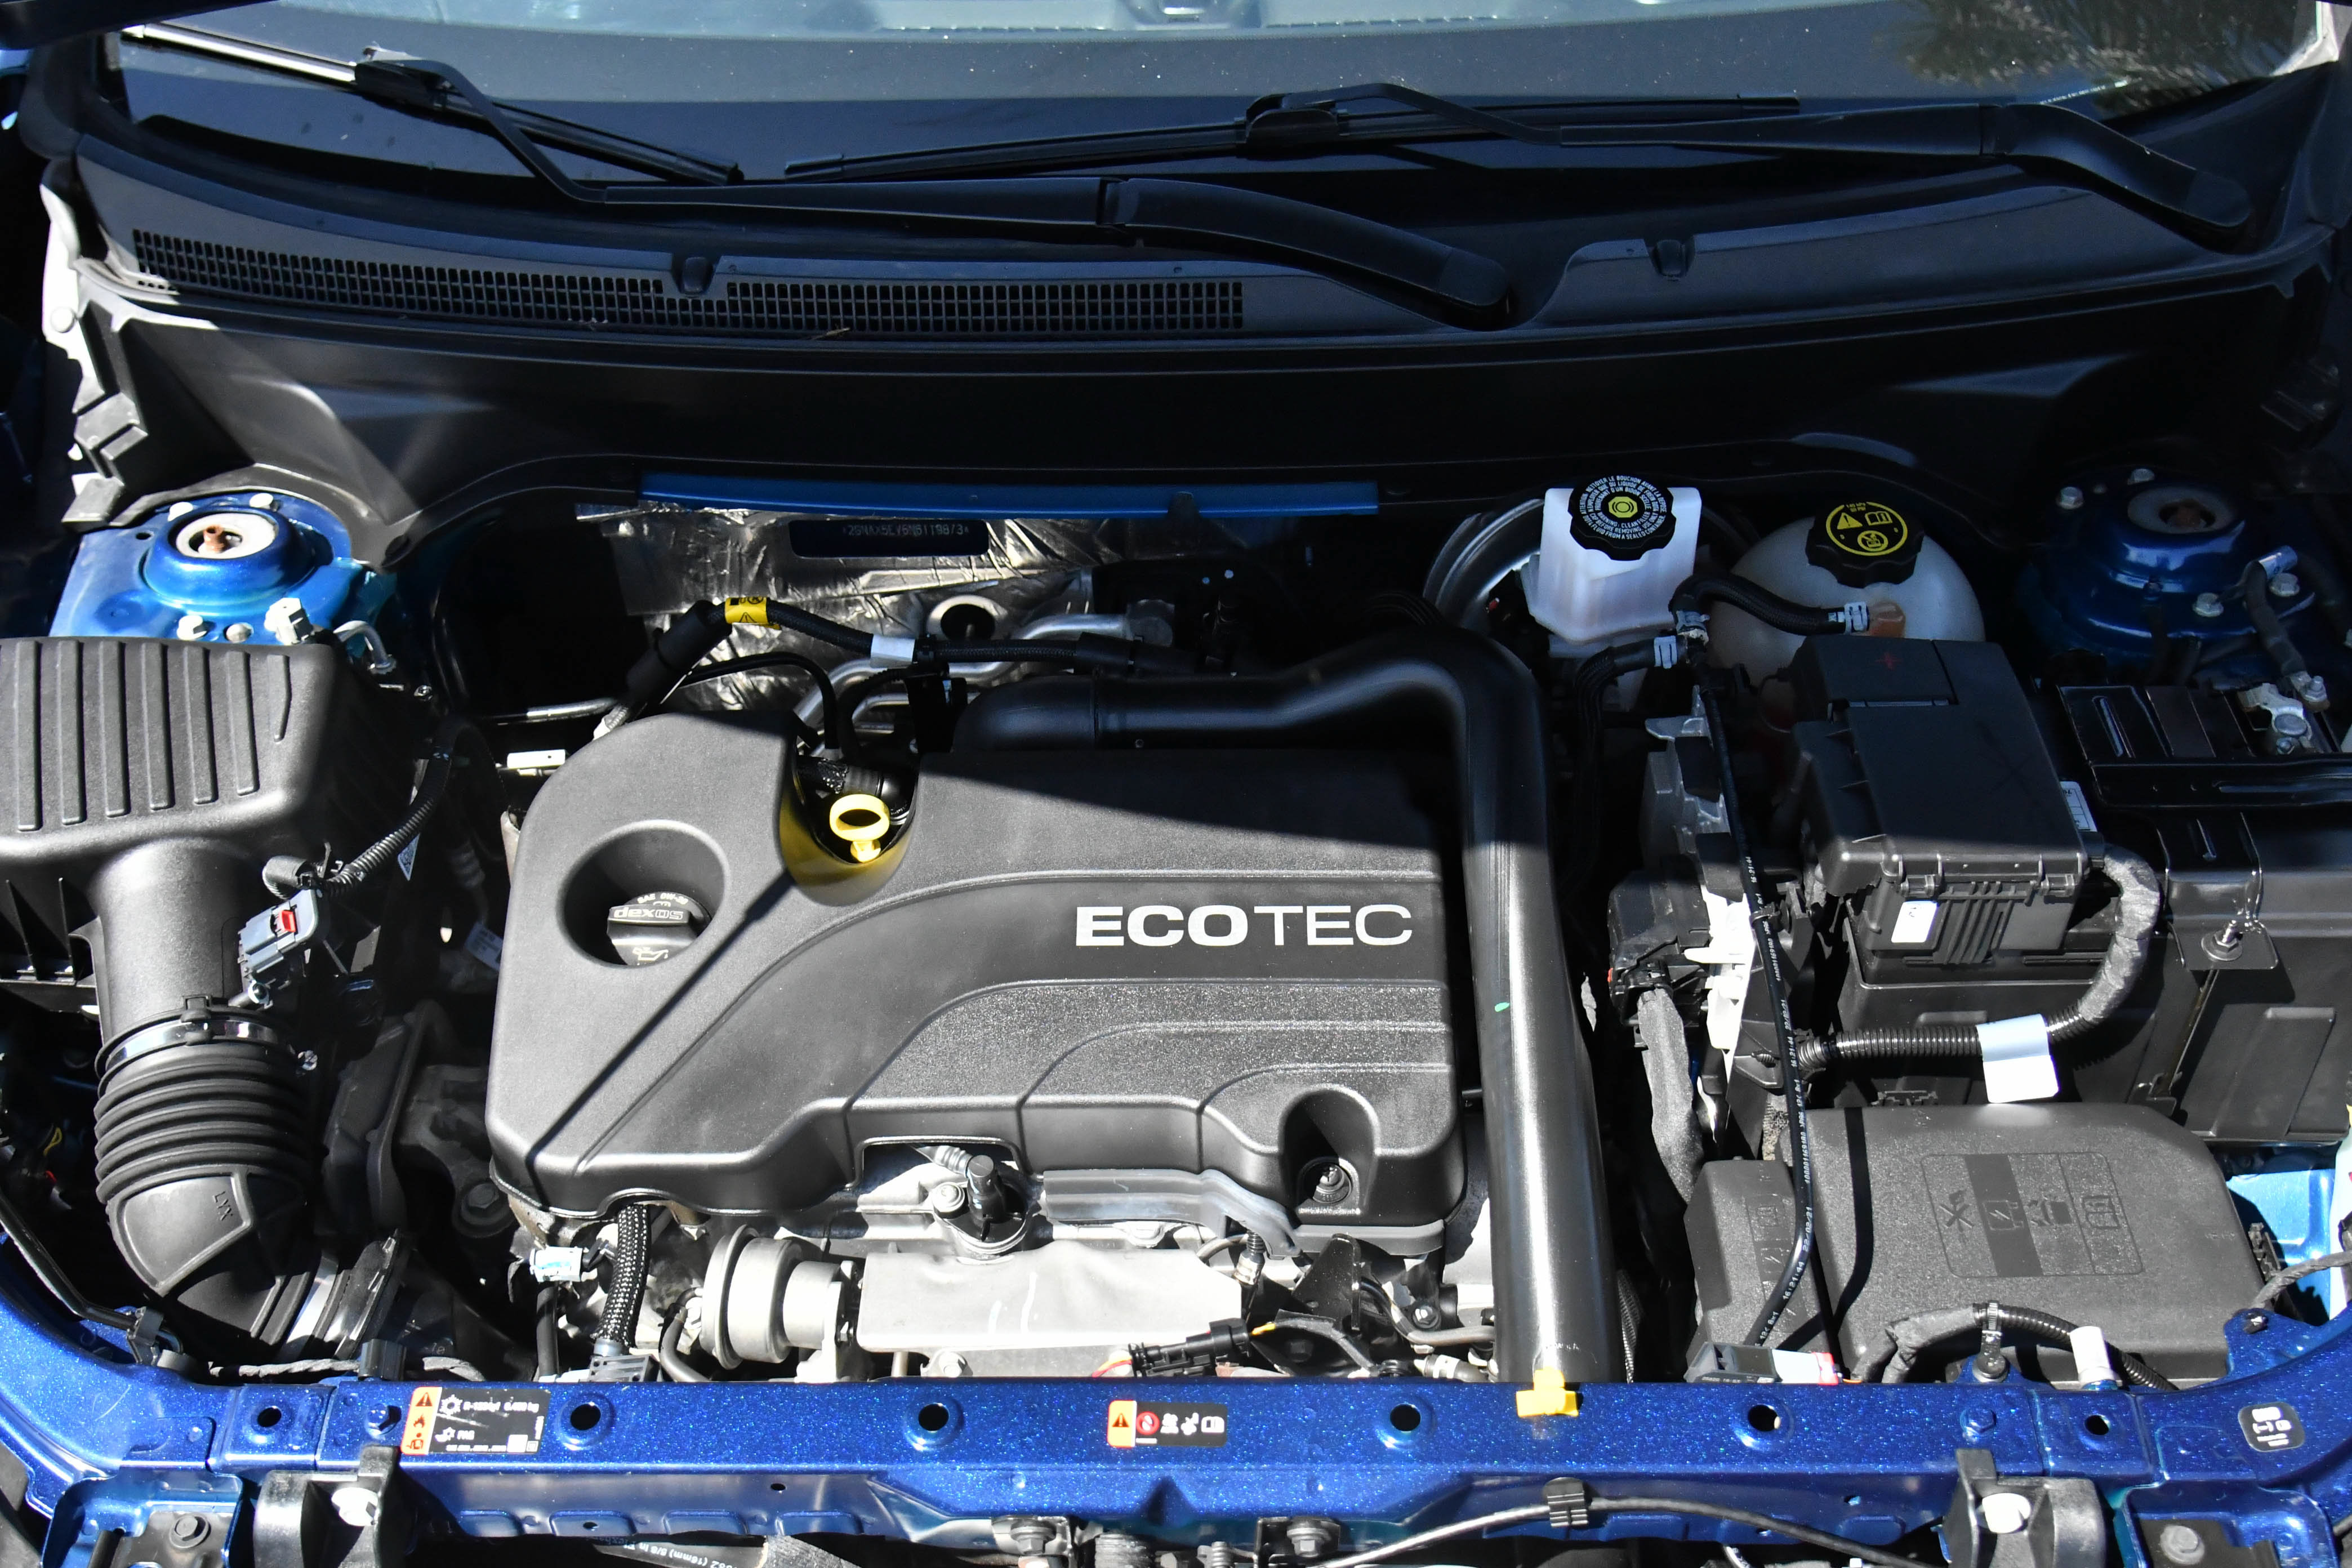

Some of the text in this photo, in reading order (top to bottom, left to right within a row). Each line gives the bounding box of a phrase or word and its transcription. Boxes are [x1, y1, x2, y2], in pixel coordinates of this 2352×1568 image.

[1625, 487, 1641, 496] BIDON
[1641, 480, 1658, 492] AVANT
[1589, 513, 1598, 522] CAP
[1596, 519, 1614, 531] BEFORE
[1649, 512, 1659, 524] ONLY
[1637, 511, 1650, 524] FILLER
[1591, 524, 1606, 534] FLUID
[1626, 531, 1646, 540] SEALED
[1745, 856, 1757, 883] 16:21:44
[638, 893, 656, 904] SAE
[614, 907, 684, 920] dexos
[1076, 904, 1412, 946] ECOTEC
[1781, 999, 1792, 1031] 22/02/21
[1789, 1036, 1798, 1068] 16:21:44
[1783, 1261, 1805, 1300] 16:21:44
[1802, 1206, 1813, 1253] 22/02/21
